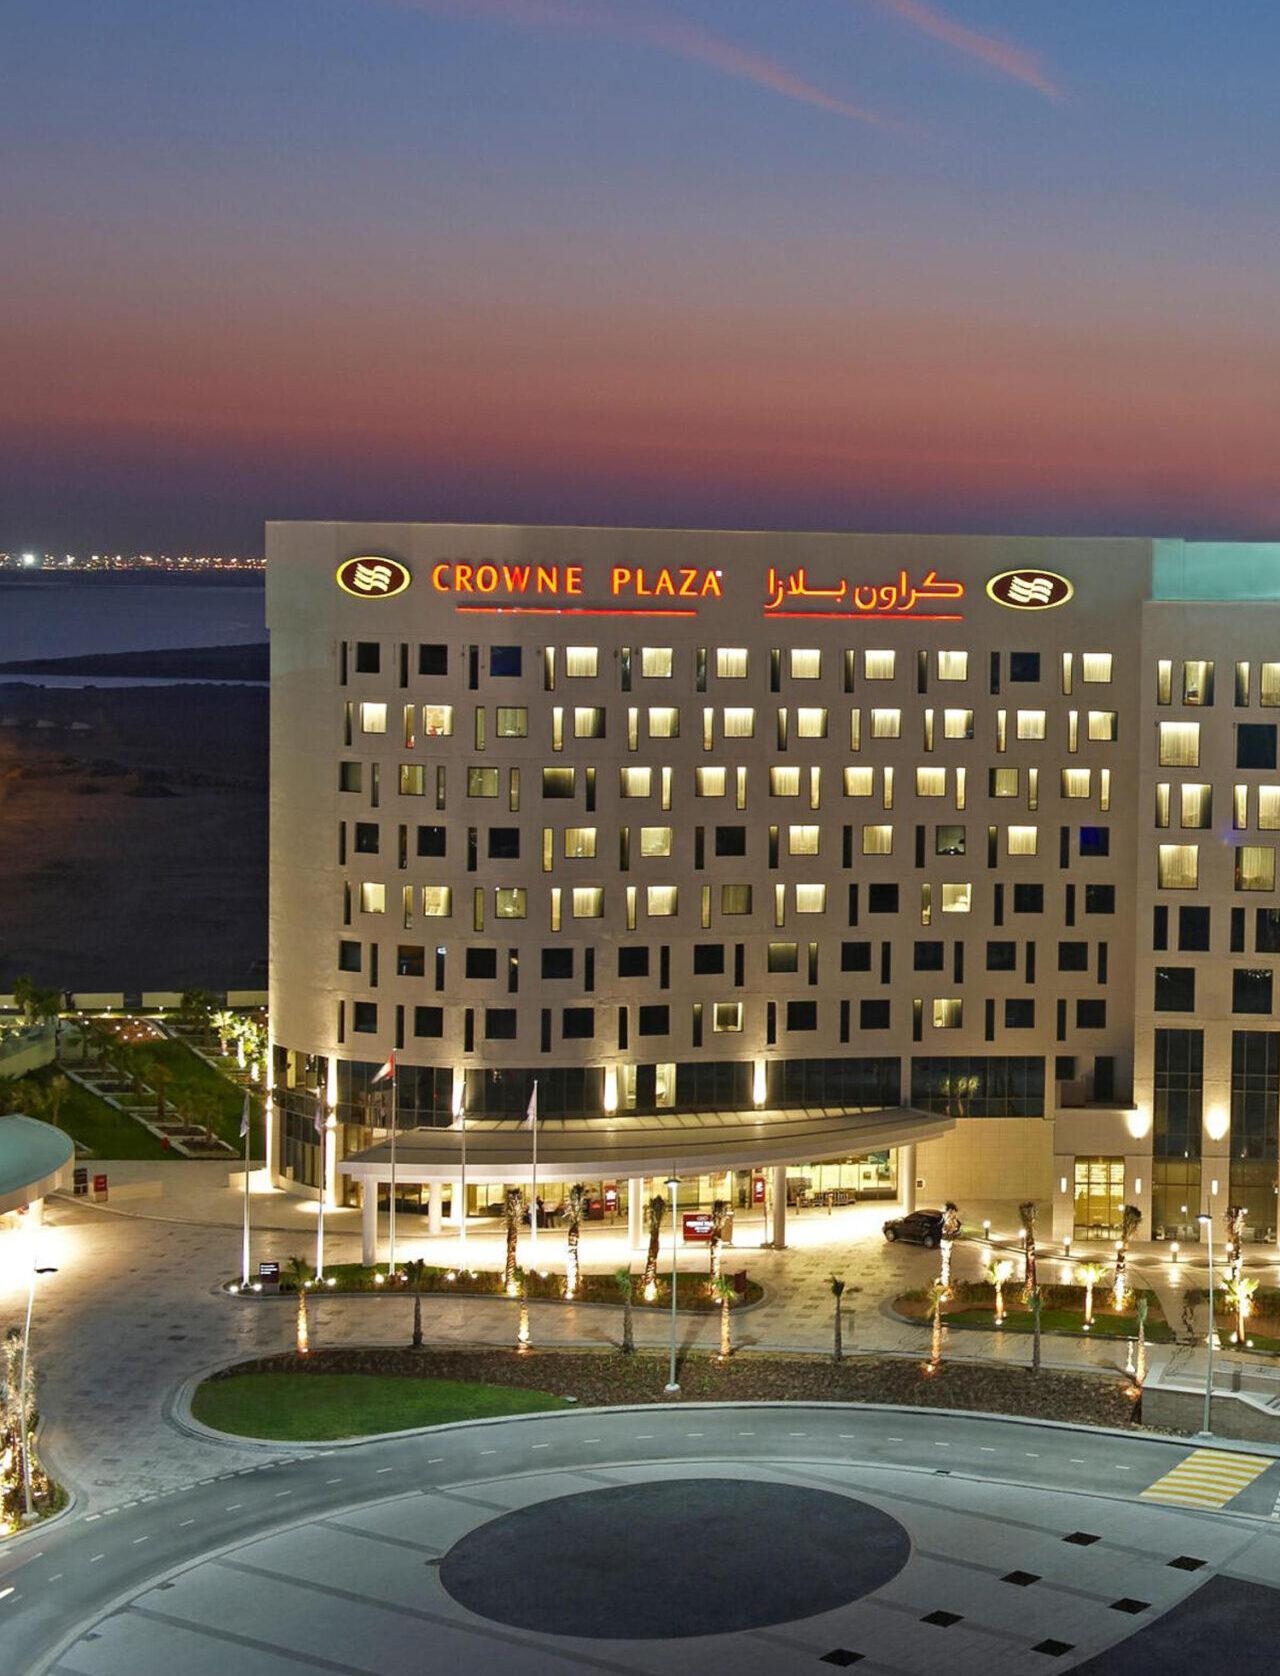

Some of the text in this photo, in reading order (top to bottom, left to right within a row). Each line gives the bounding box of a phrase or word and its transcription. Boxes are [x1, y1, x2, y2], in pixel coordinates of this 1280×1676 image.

[431, 563, 722, 597] CROWNE PLAZA
[854, 570, 965, 610] كراون
